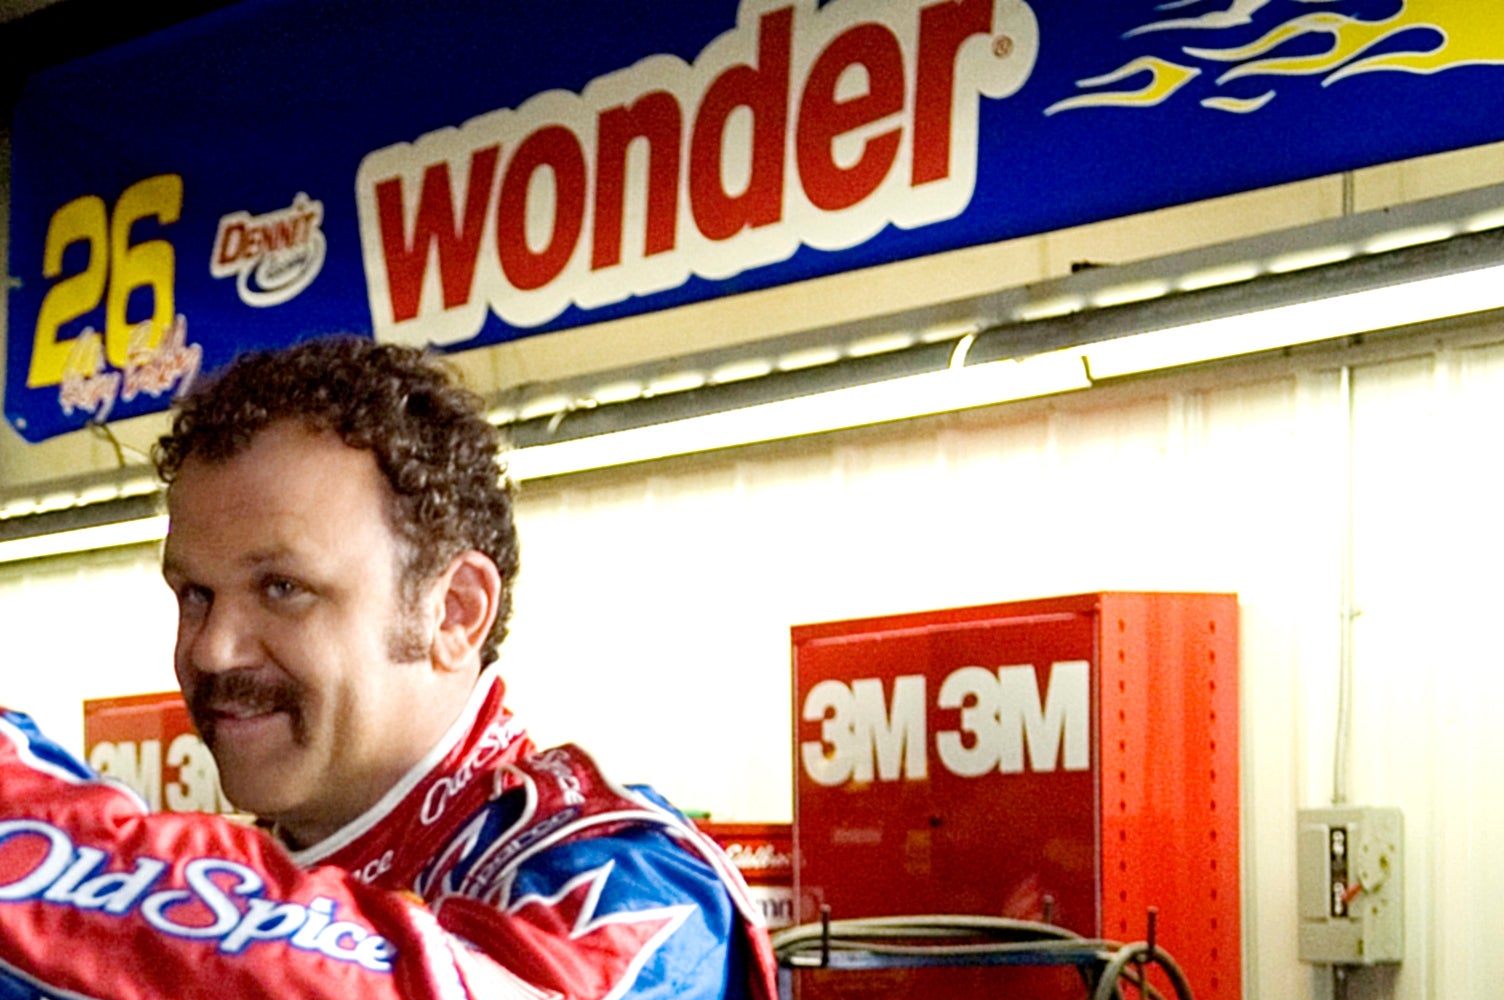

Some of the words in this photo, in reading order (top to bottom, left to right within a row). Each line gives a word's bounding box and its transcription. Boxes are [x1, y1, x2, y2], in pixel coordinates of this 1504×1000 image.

[374, 0, 994, 325] wonder
[26, 173, 184, 389] 26
[800, 674, 928, 787] 3M
[934, 659, 1091, 779] 3M
[142, 858, 396, 974] Spice
